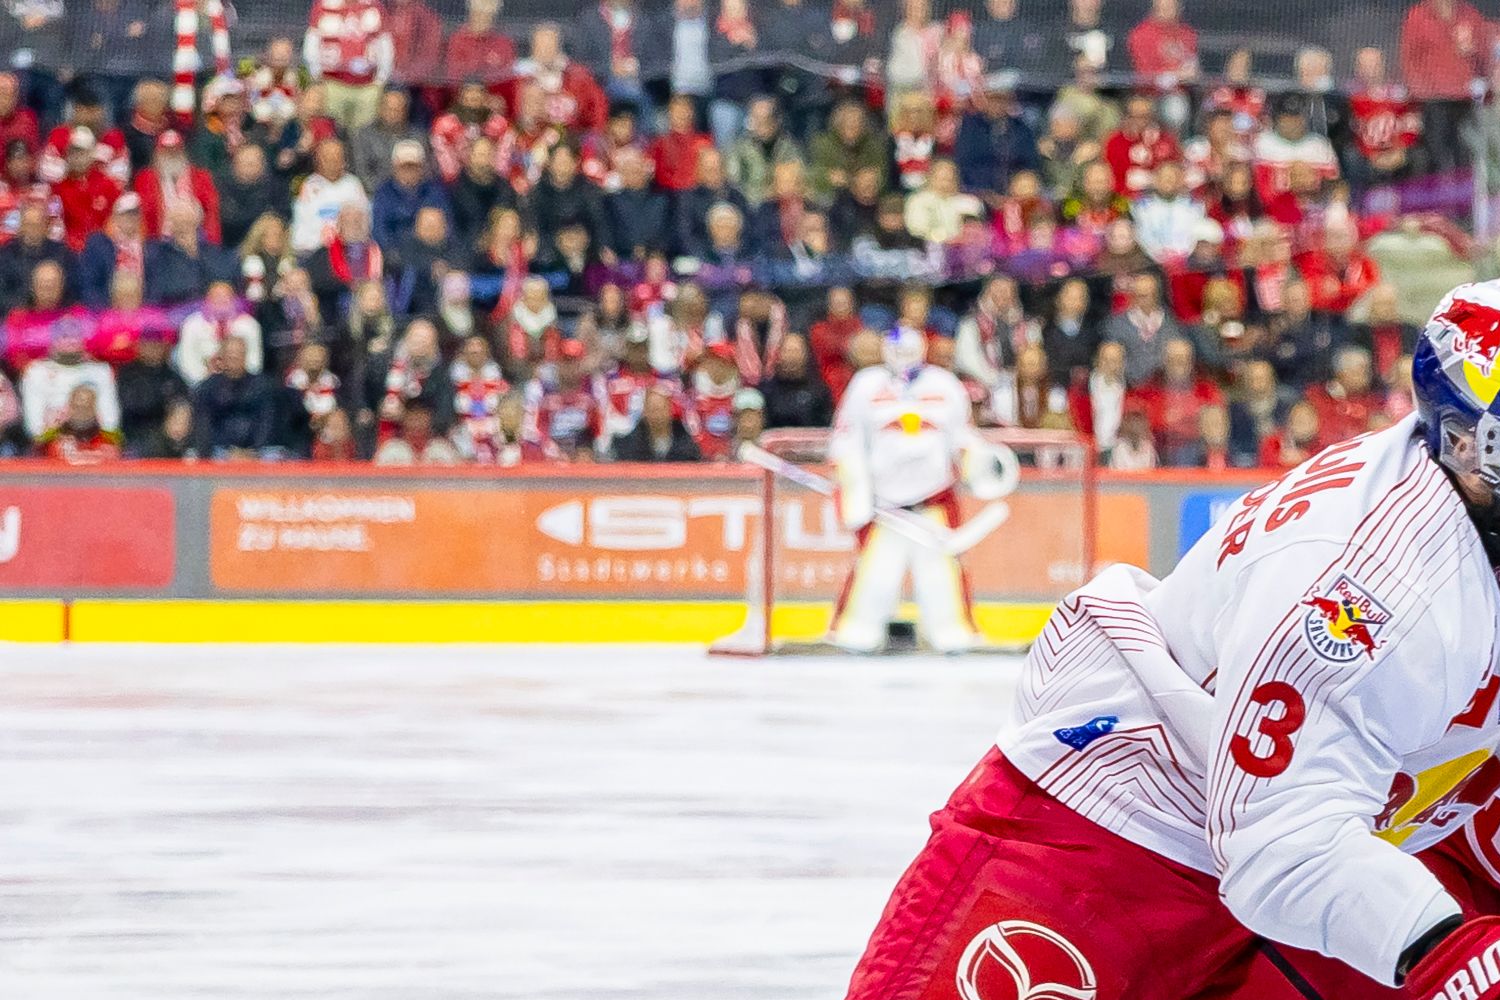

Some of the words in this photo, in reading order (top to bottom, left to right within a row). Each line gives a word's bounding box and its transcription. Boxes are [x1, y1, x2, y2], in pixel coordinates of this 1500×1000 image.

[1335, 580, 1363, 605] Red
[1359, 596, 1387, 624] Bull
[1230, 681, 1306, 778] 3
